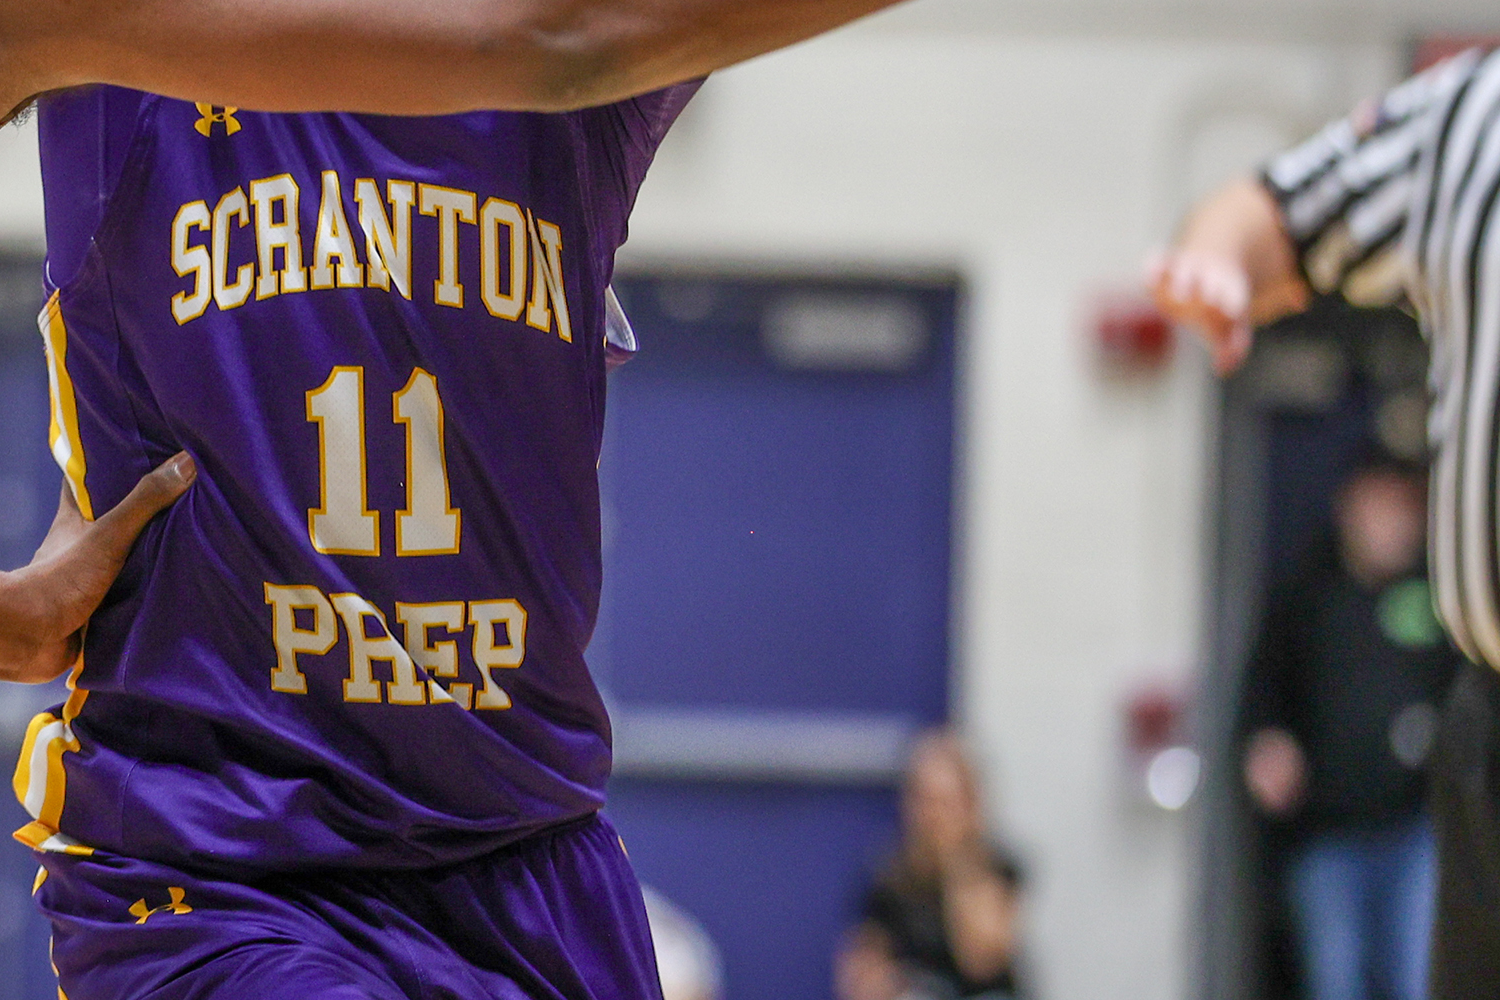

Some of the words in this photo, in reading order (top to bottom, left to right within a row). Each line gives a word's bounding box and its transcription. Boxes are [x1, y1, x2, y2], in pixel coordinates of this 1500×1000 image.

[170, 170, 573, 344] SCRANTON
[305, 365, 461, 557] 11
[263, 581, 528, 710] PREP
